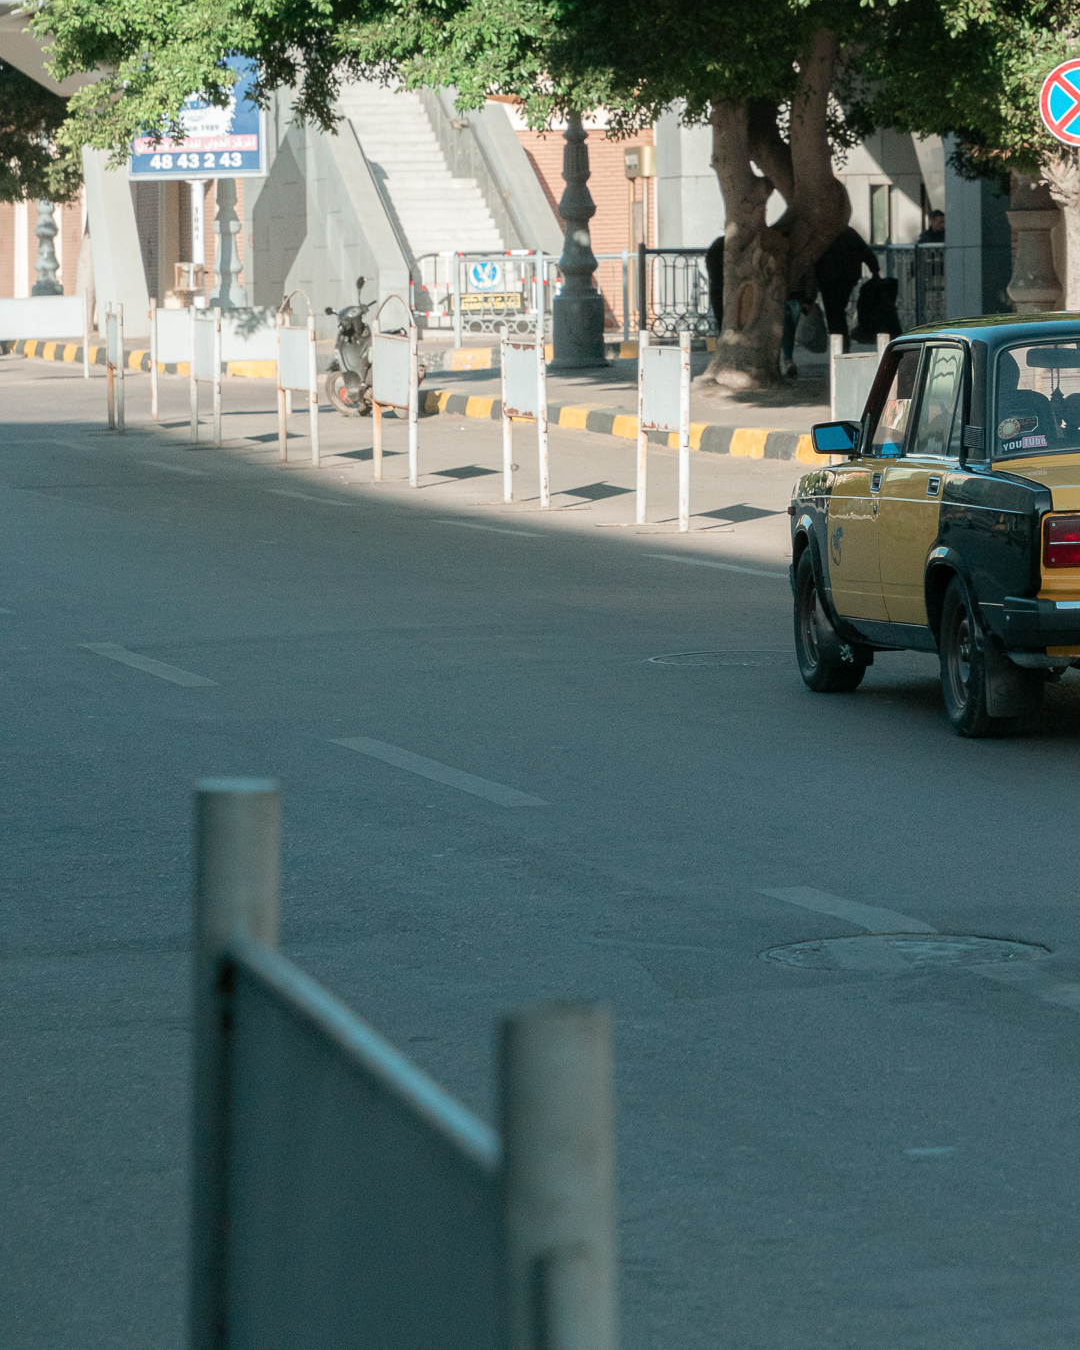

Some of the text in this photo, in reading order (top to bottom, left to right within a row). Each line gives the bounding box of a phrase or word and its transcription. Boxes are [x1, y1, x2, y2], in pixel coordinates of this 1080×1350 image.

[150, 152, 242, 169] 48 43 2 43
